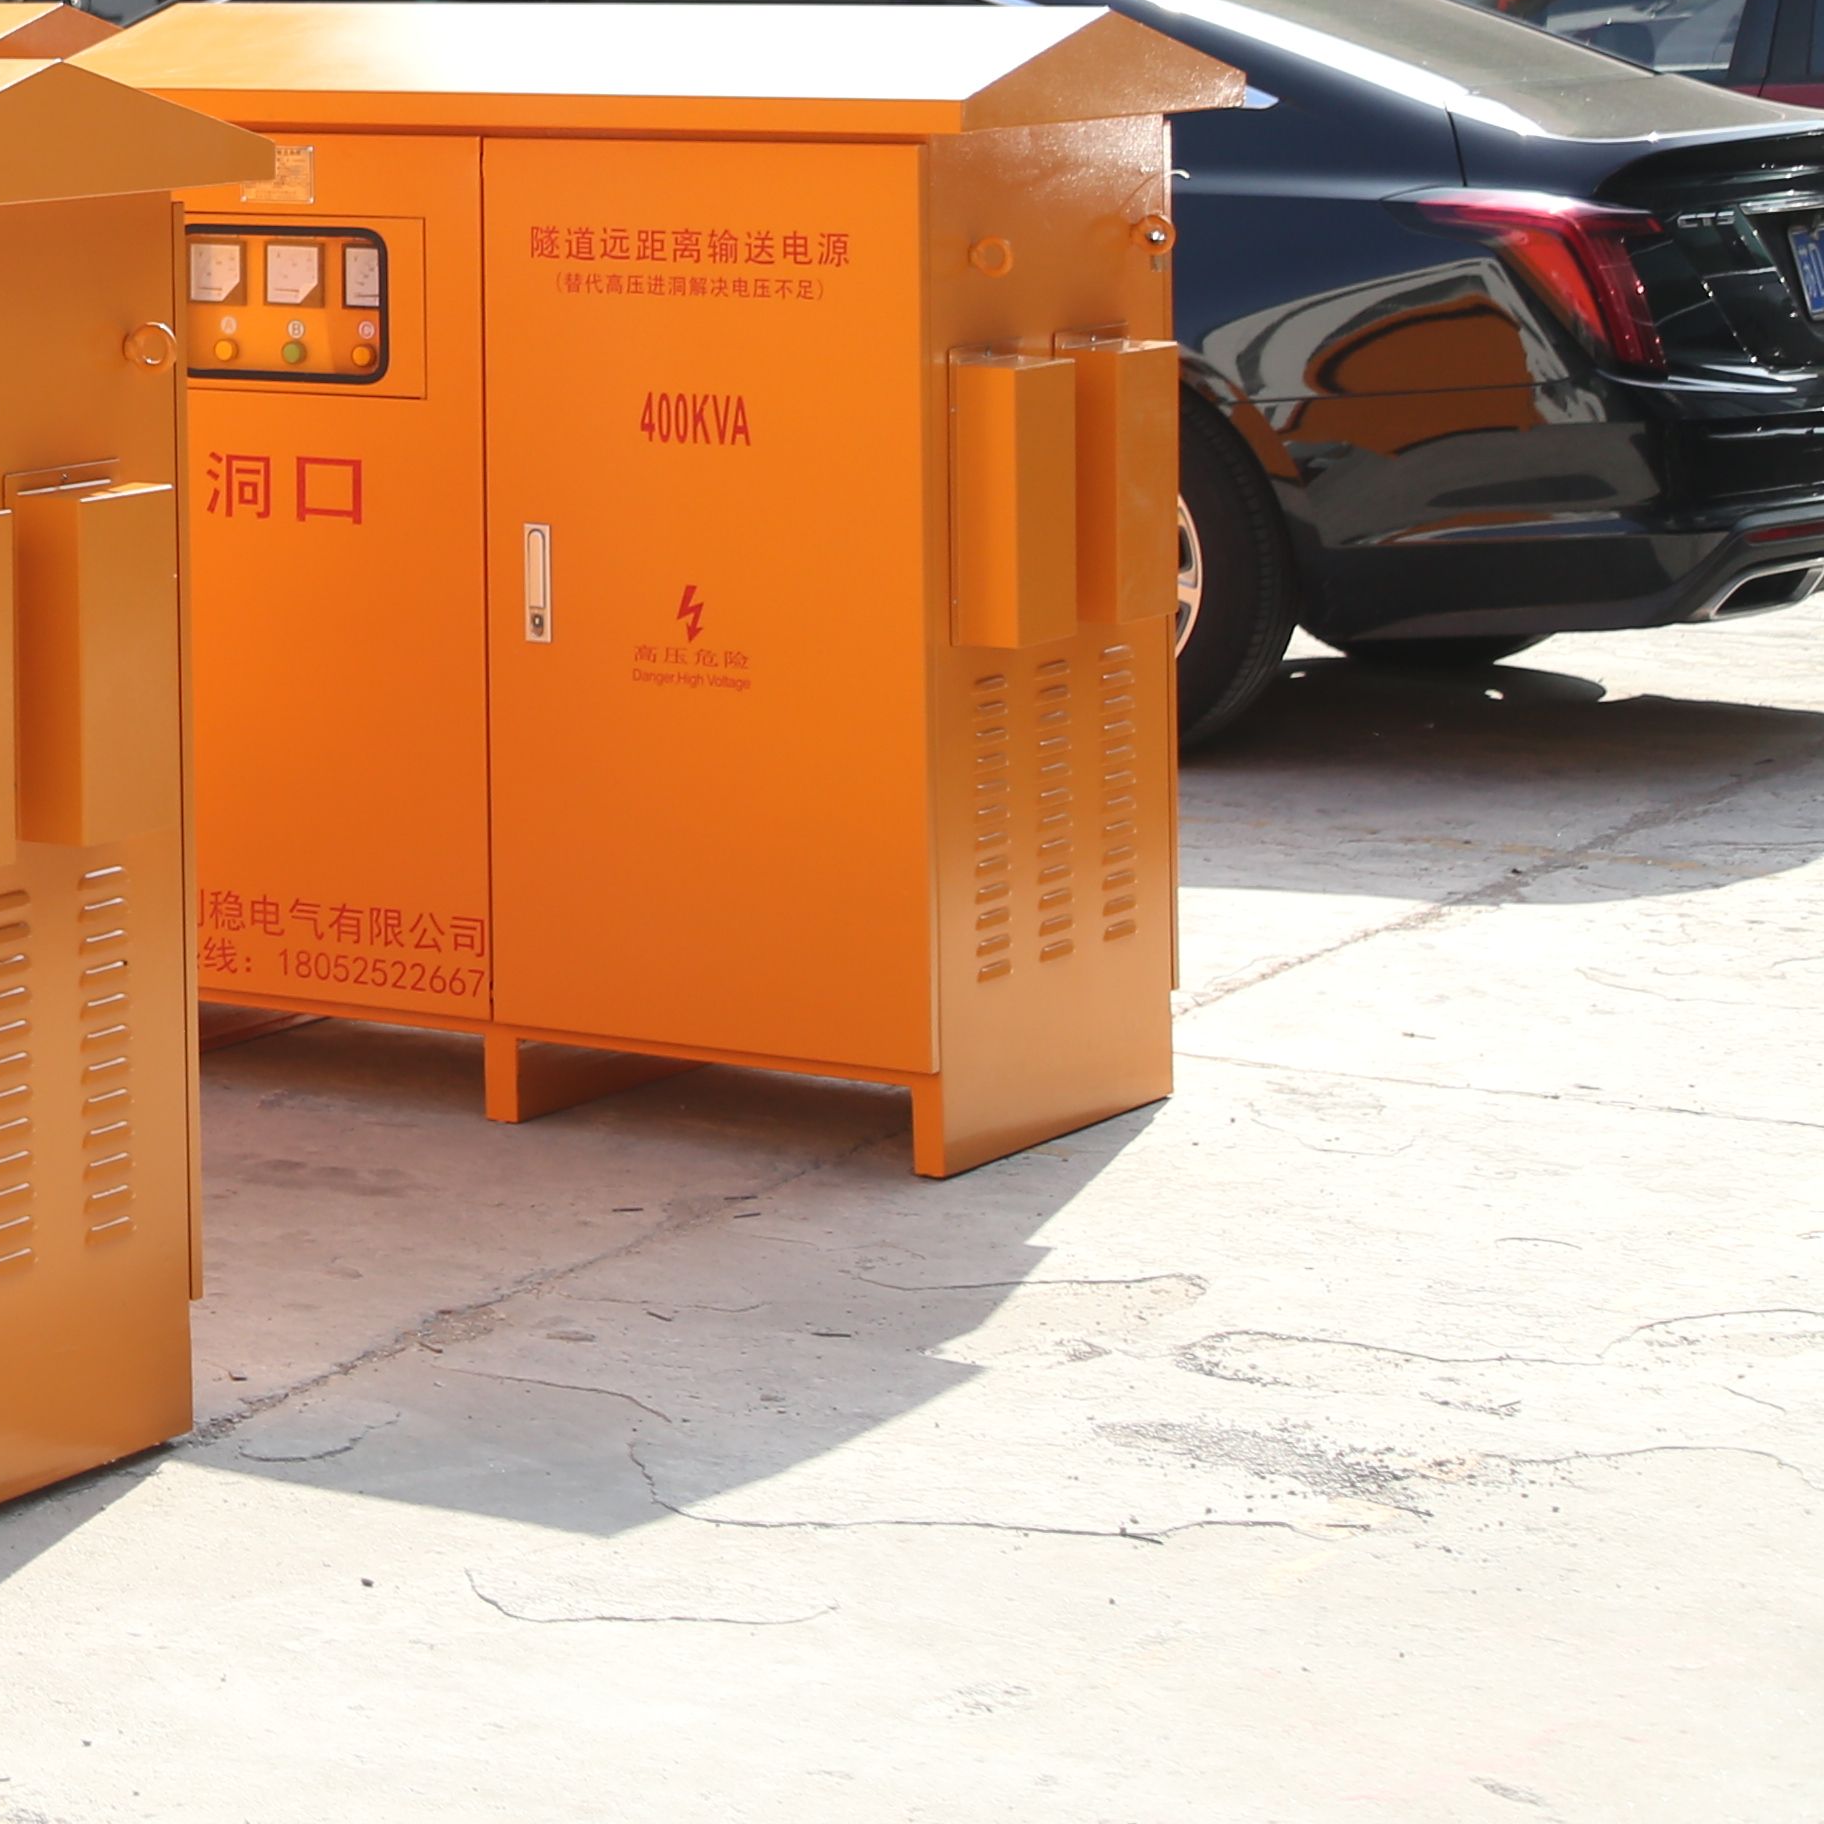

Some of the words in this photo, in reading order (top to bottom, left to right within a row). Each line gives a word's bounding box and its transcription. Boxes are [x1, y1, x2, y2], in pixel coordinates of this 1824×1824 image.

[530, 226, 850, 268] 隧道远距离输送电源
[640, 391, 751, 447] 400KVA
[206, 451, 363, 526] 洞口
[634, 644, 750, 669] 高压危险
[278, 948, 485, 998] 18052522667
